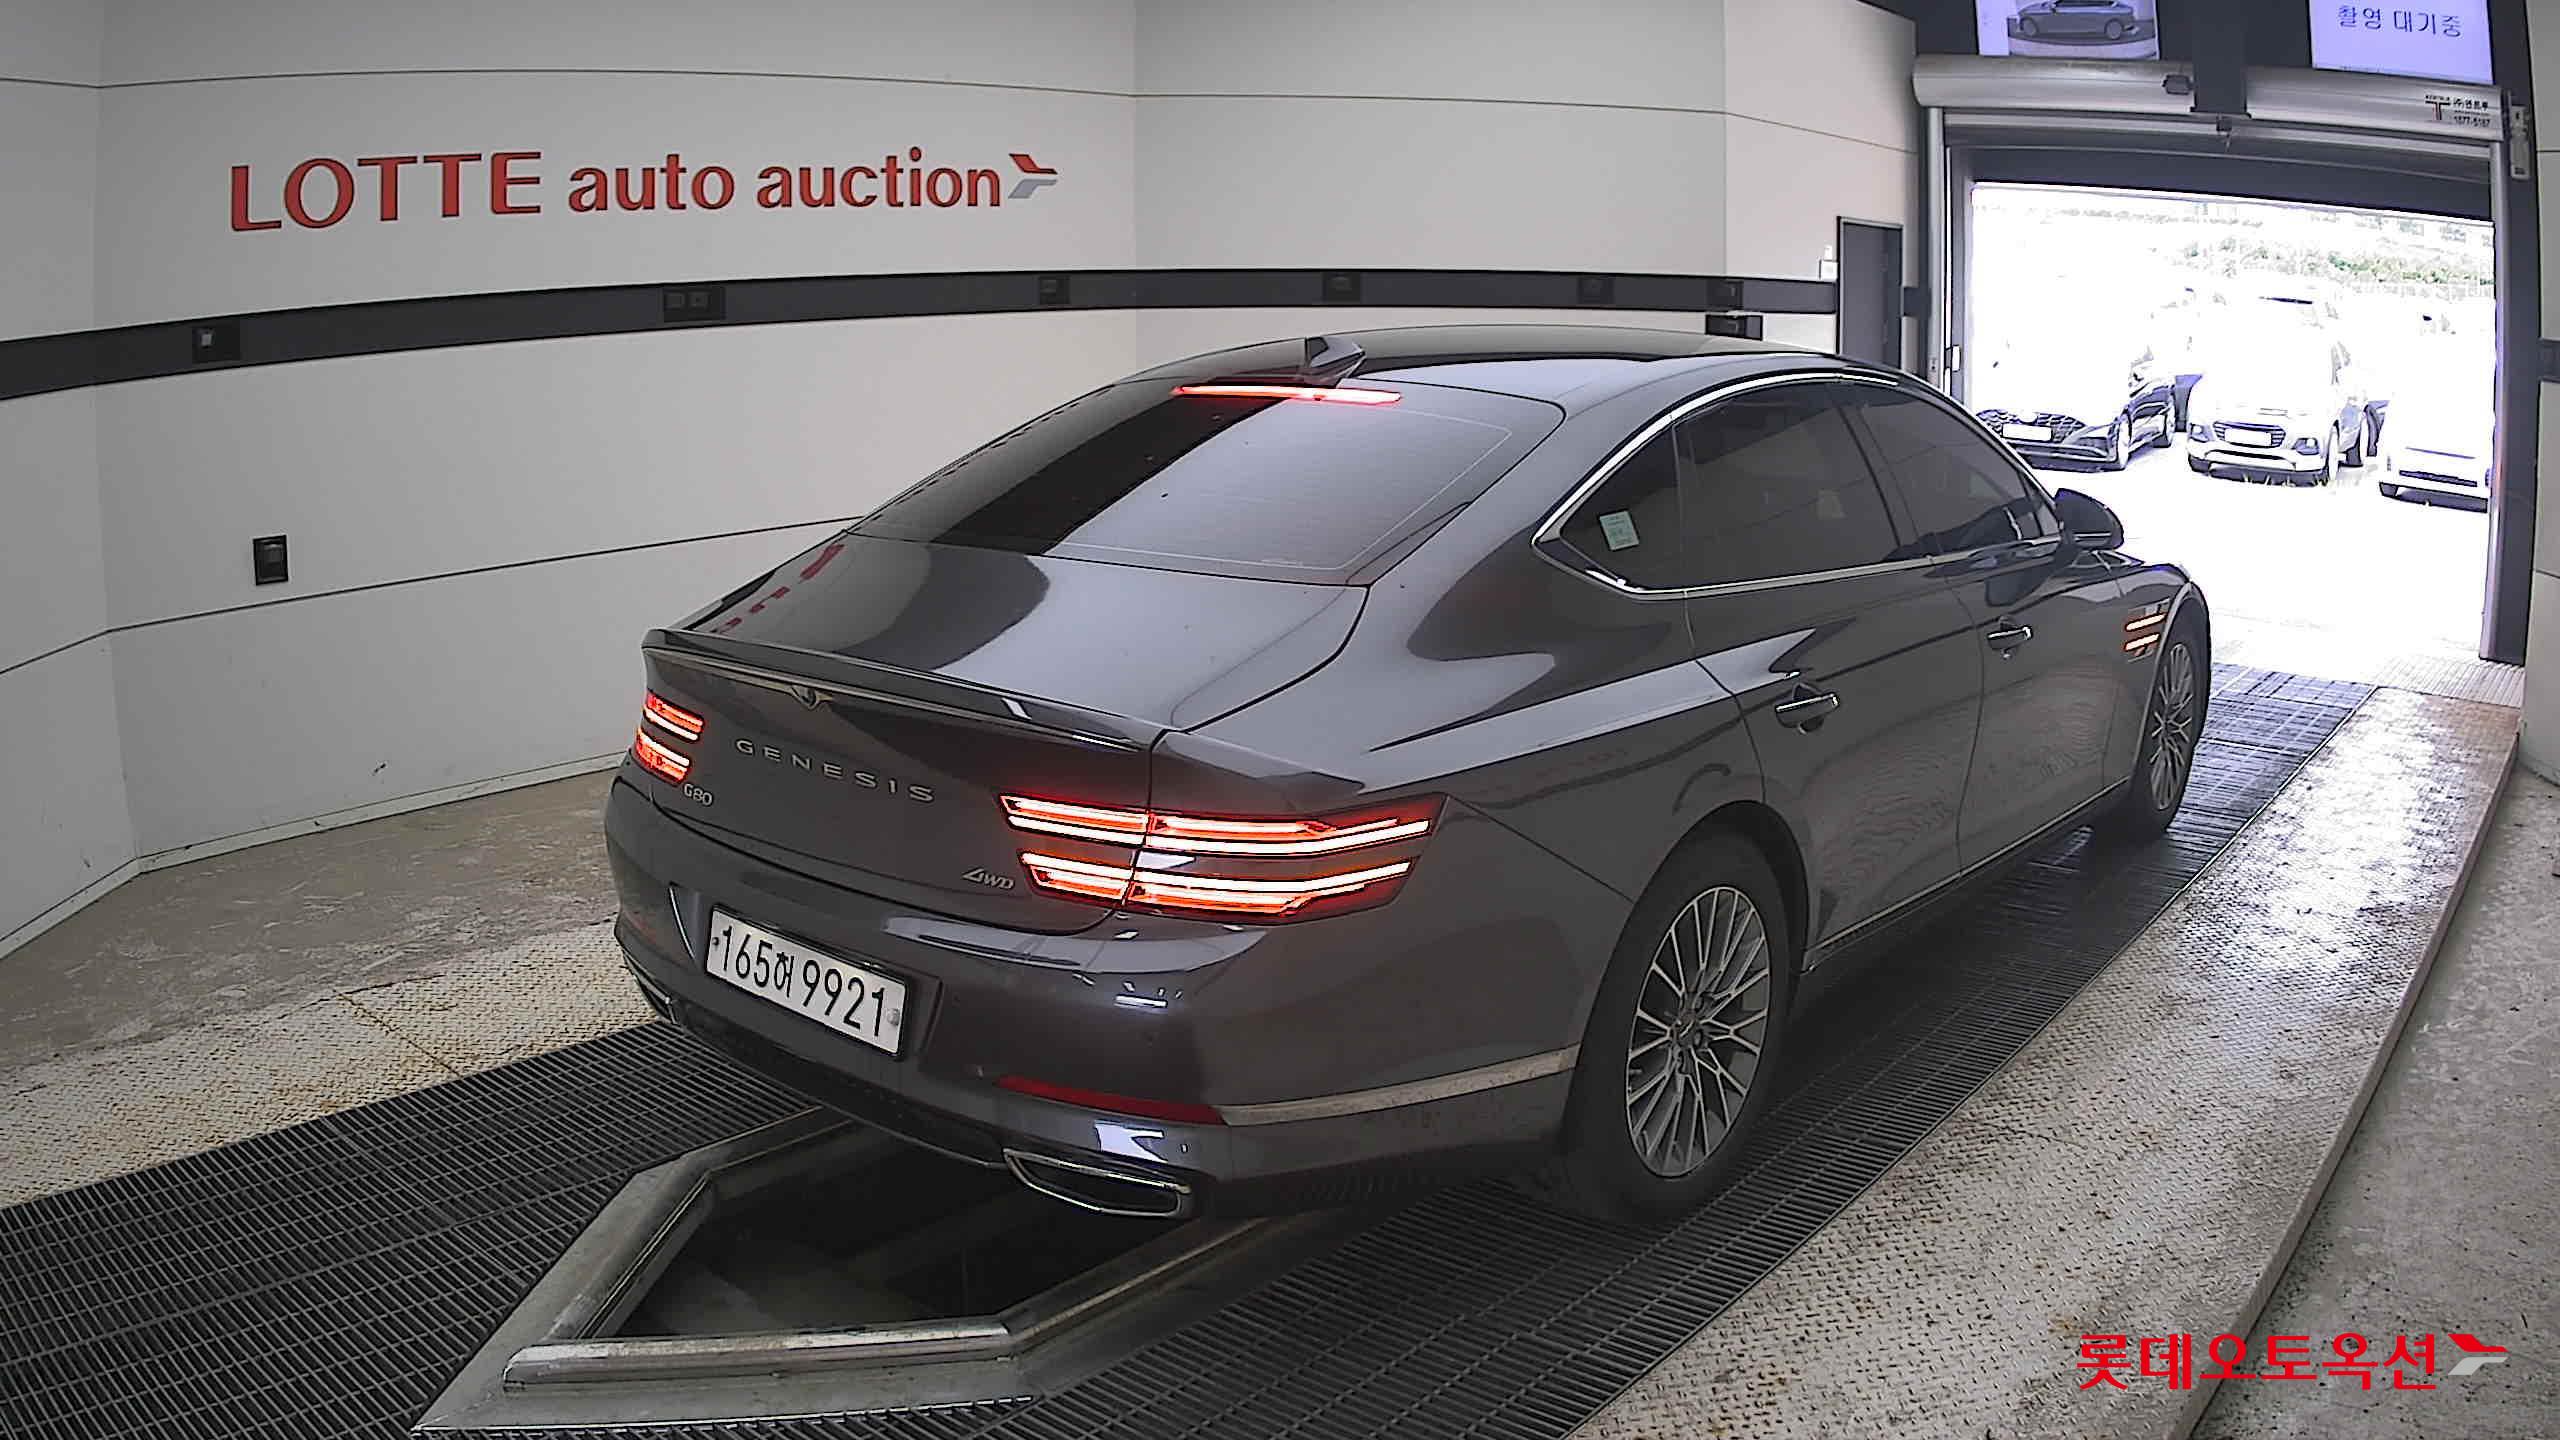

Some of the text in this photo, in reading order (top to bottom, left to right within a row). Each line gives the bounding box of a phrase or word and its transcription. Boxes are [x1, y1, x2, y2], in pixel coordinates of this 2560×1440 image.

[2338, 5, 2461, 38] 촬영 대기중
[231, 146, 1001, 232] LOTTE auto auction
[683, 782, 713, 807] G80
[735, 738, 935, 803] GENESIS
[962, 867, 1016, 891] 4WD
[722, 925, 885, 1037] 165허 9921
